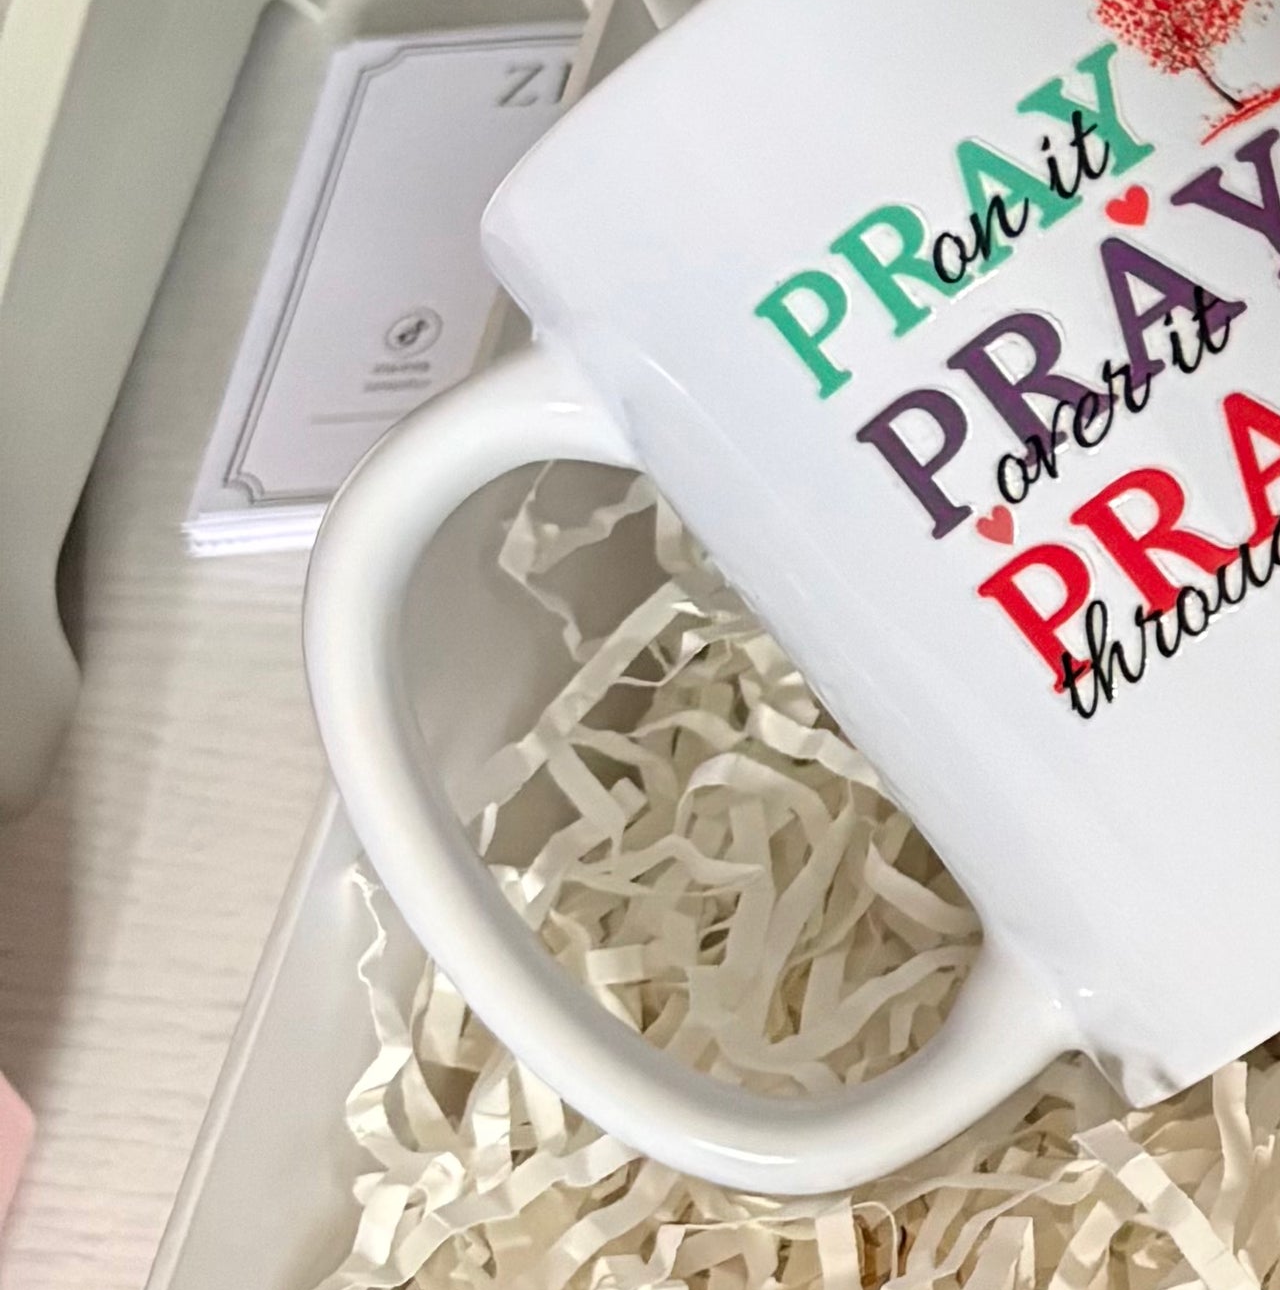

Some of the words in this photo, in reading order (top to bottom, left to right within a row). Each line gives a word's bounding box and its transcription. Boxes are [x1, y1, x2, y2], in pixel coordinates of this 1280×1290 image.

[755, 44, 1155, 400] PRAY
[932, 195, 1029, 284] on
[1042, 110, 1109, 200] it
[998, 357, 1151, 504] over
[1163, 285, 1231, 376] it
